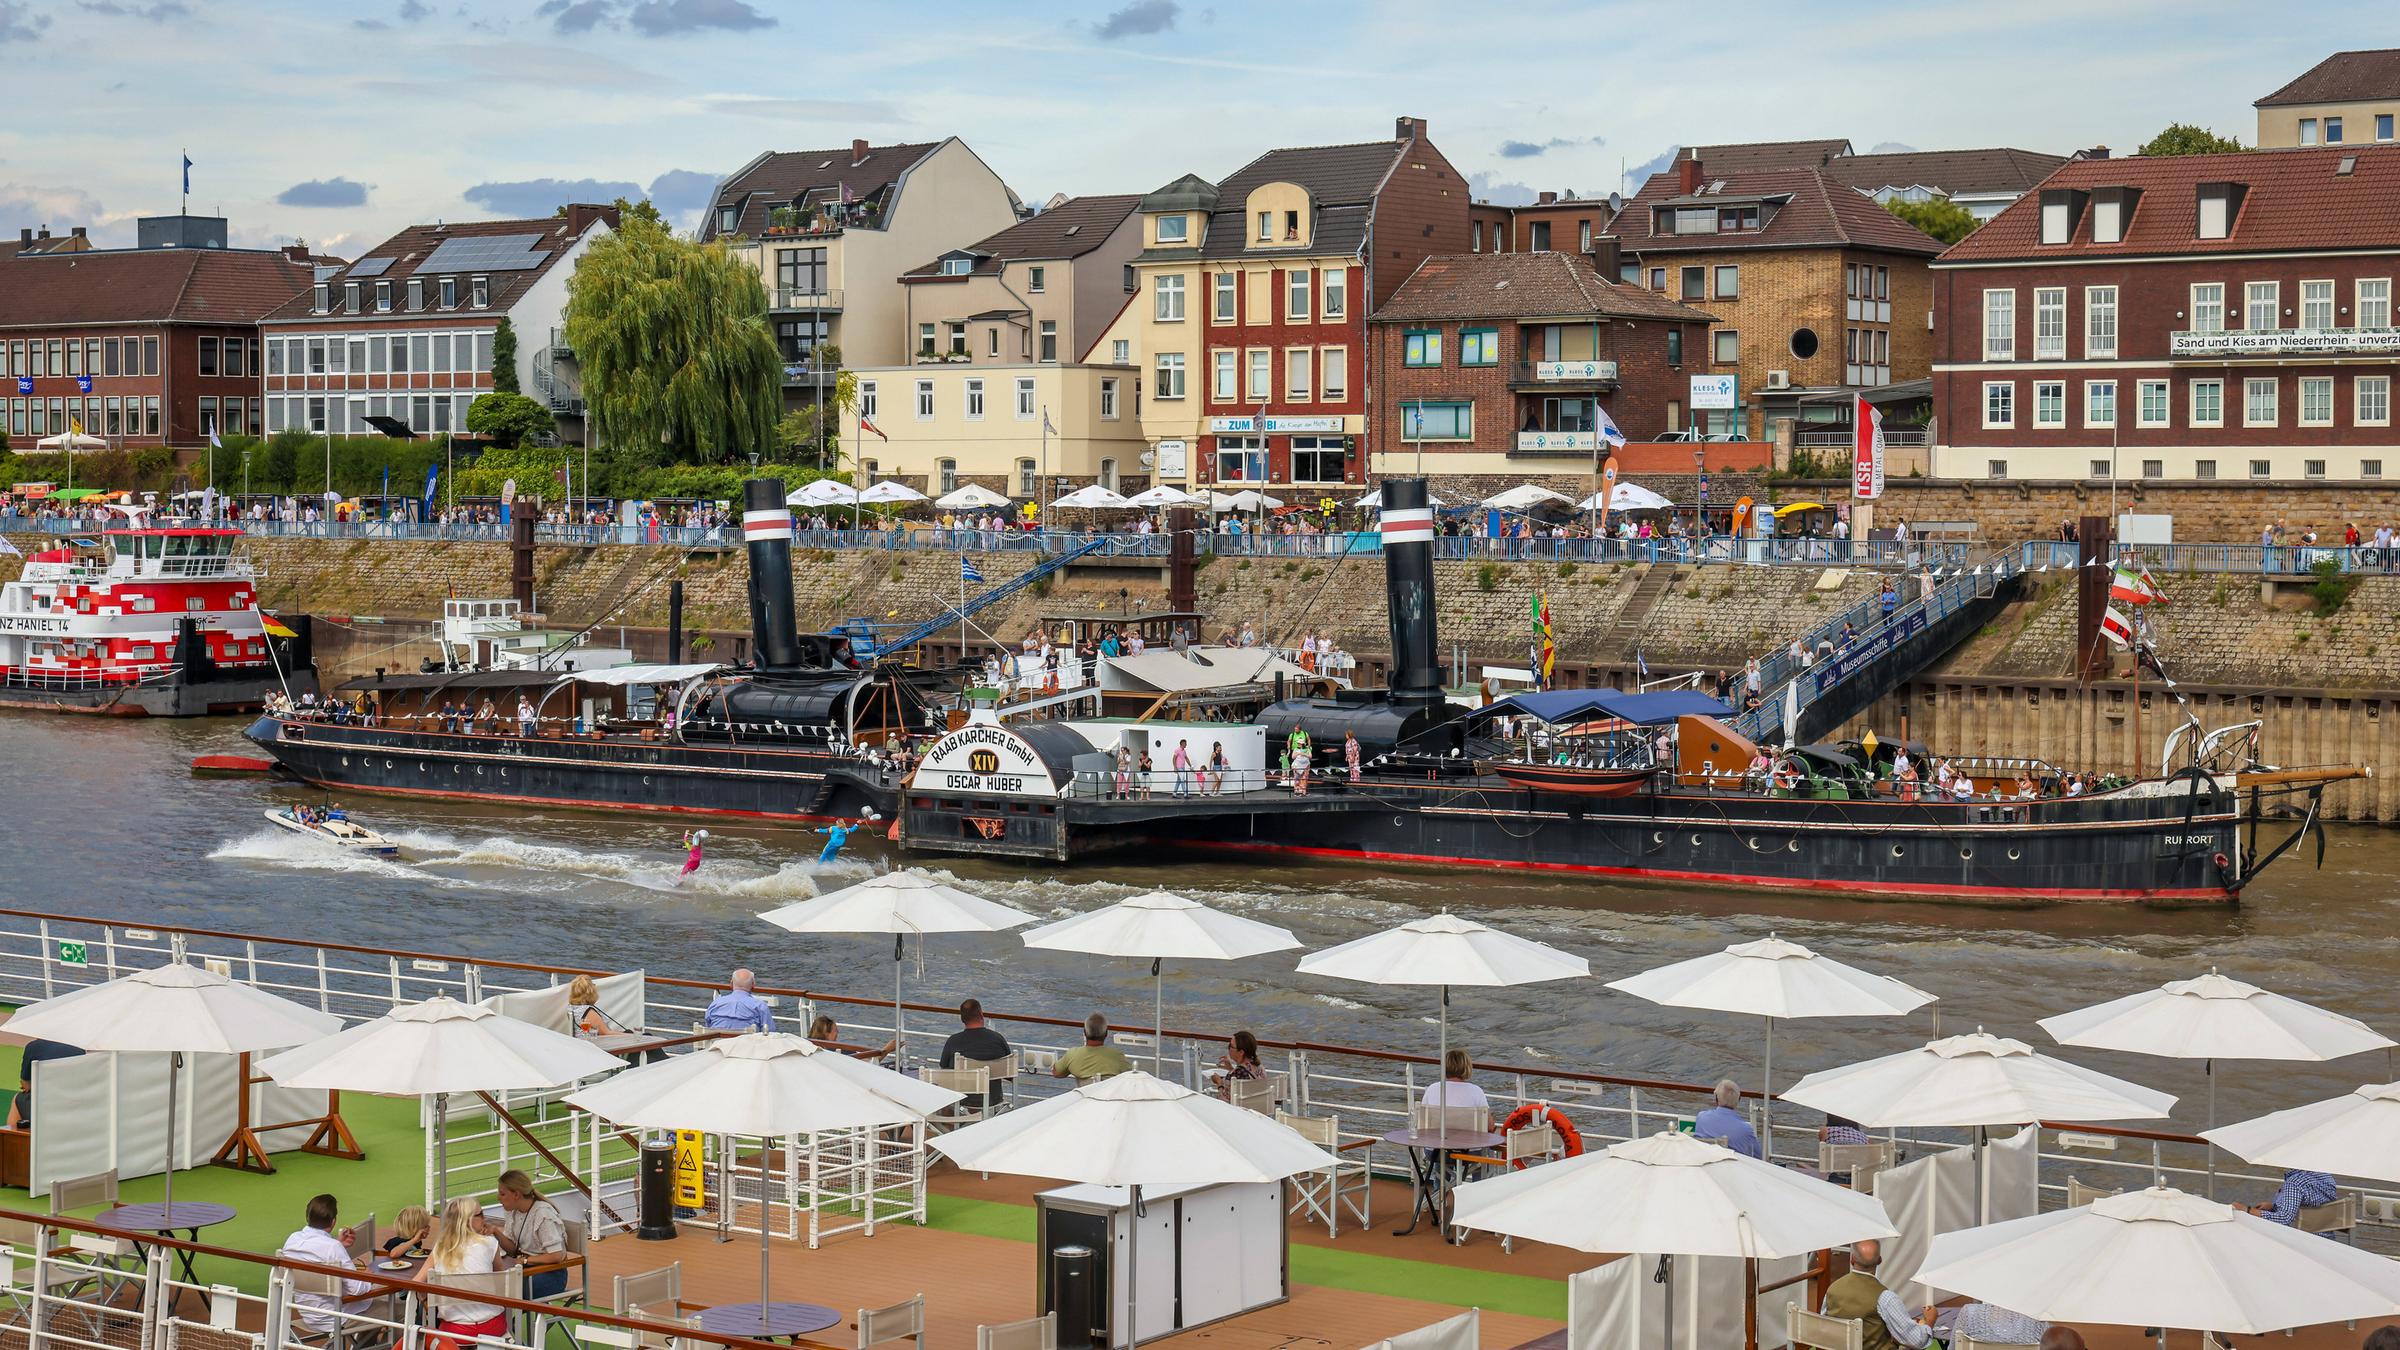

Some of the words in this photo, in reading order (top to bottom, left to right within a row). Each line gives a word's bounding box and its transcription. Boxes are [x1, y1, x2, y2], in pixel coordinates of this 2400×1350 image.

[2177, 337, 2205, 348] Sand
[2208, 336, 2229, 347] und
[2232, 335, 2256, 346] Kies
[2258, 337, 2277, 346] am
[2280, 334, 2349, 346] Niederrhein
[1228, 420, 1250, 430] ZUM
[1253, 420, 1276, 430] BI
[1875, 457, 1883, 480] METAL
[1858, 461, 1871, 496] TSR
[17, 618, 53, 631] HANIEL
[59, 620, 69, 632] 14
[1840, 637, 1888, 675] Museumsschiffe
[931, 736, 958, 764] RAAB
[958, 729, 1005, 747] KARCHER
[1006, 737, 1035, 767] GmbH
[973, 754, 996, 771] XIV
[947, 774, 981, 790] OSCAR
[987, 776, 1022, 792] HUBER
